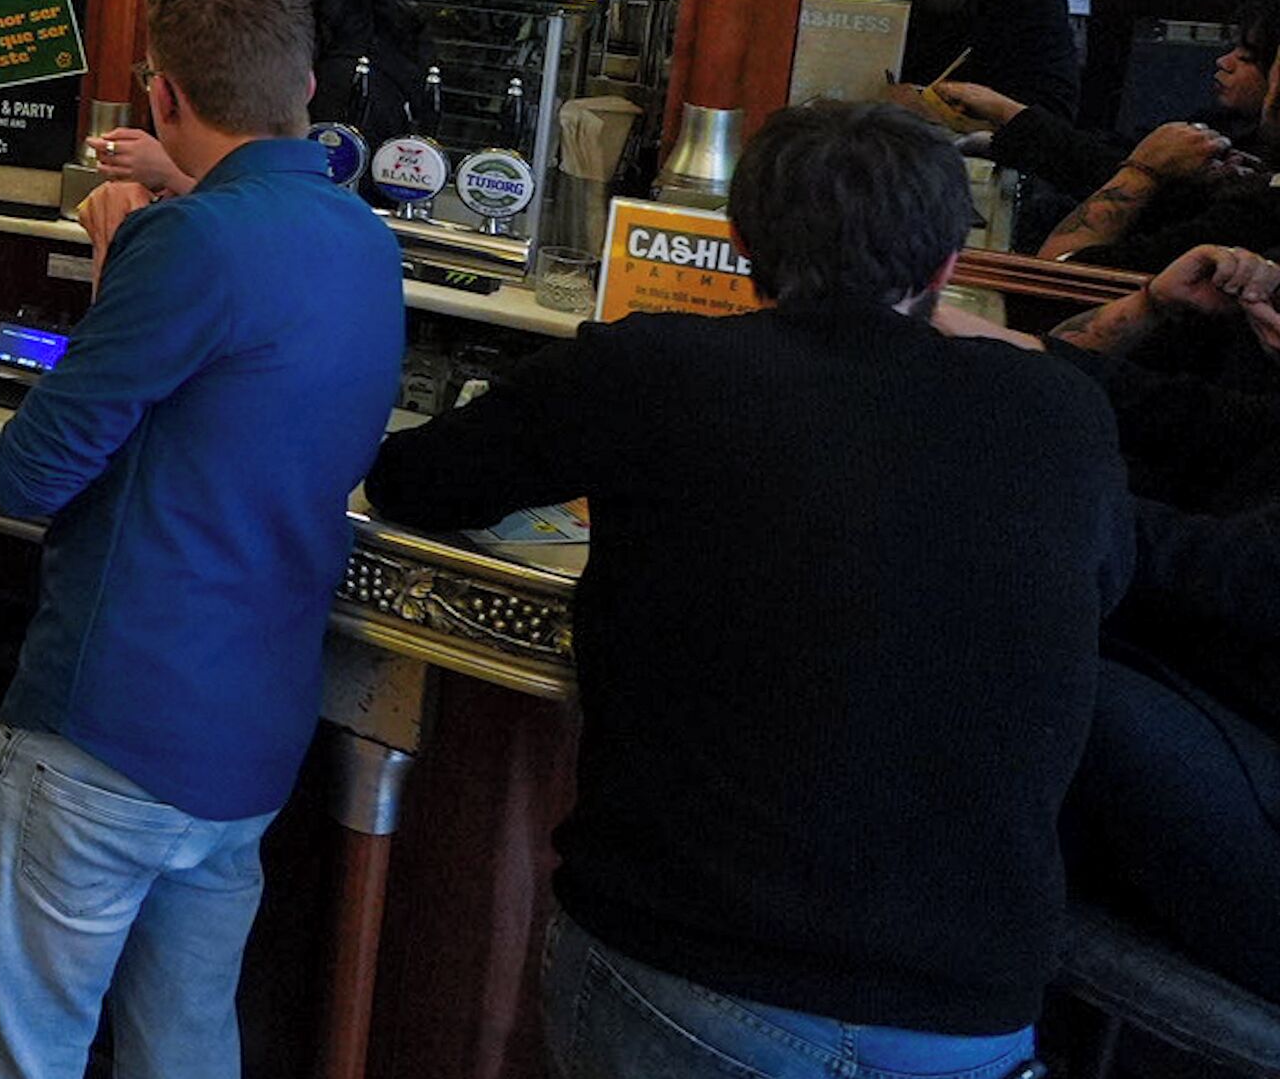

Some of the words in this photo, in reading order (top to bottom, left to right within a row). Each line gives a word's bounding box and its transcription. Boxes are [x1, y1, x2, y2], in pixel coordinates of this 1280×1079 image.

[30, 6, 61, 21] ser
[37, 23, 69, 40] ser
[1, 99, 12, 115] &
[13, 101, 55, 119] PARTY
[381, 168, 432, 186] BLANC
[466, 173, 524, 196] TUBORG
[628, 227, 753, 276] CASHLE
[625, 261, 740, 292] PAYME
